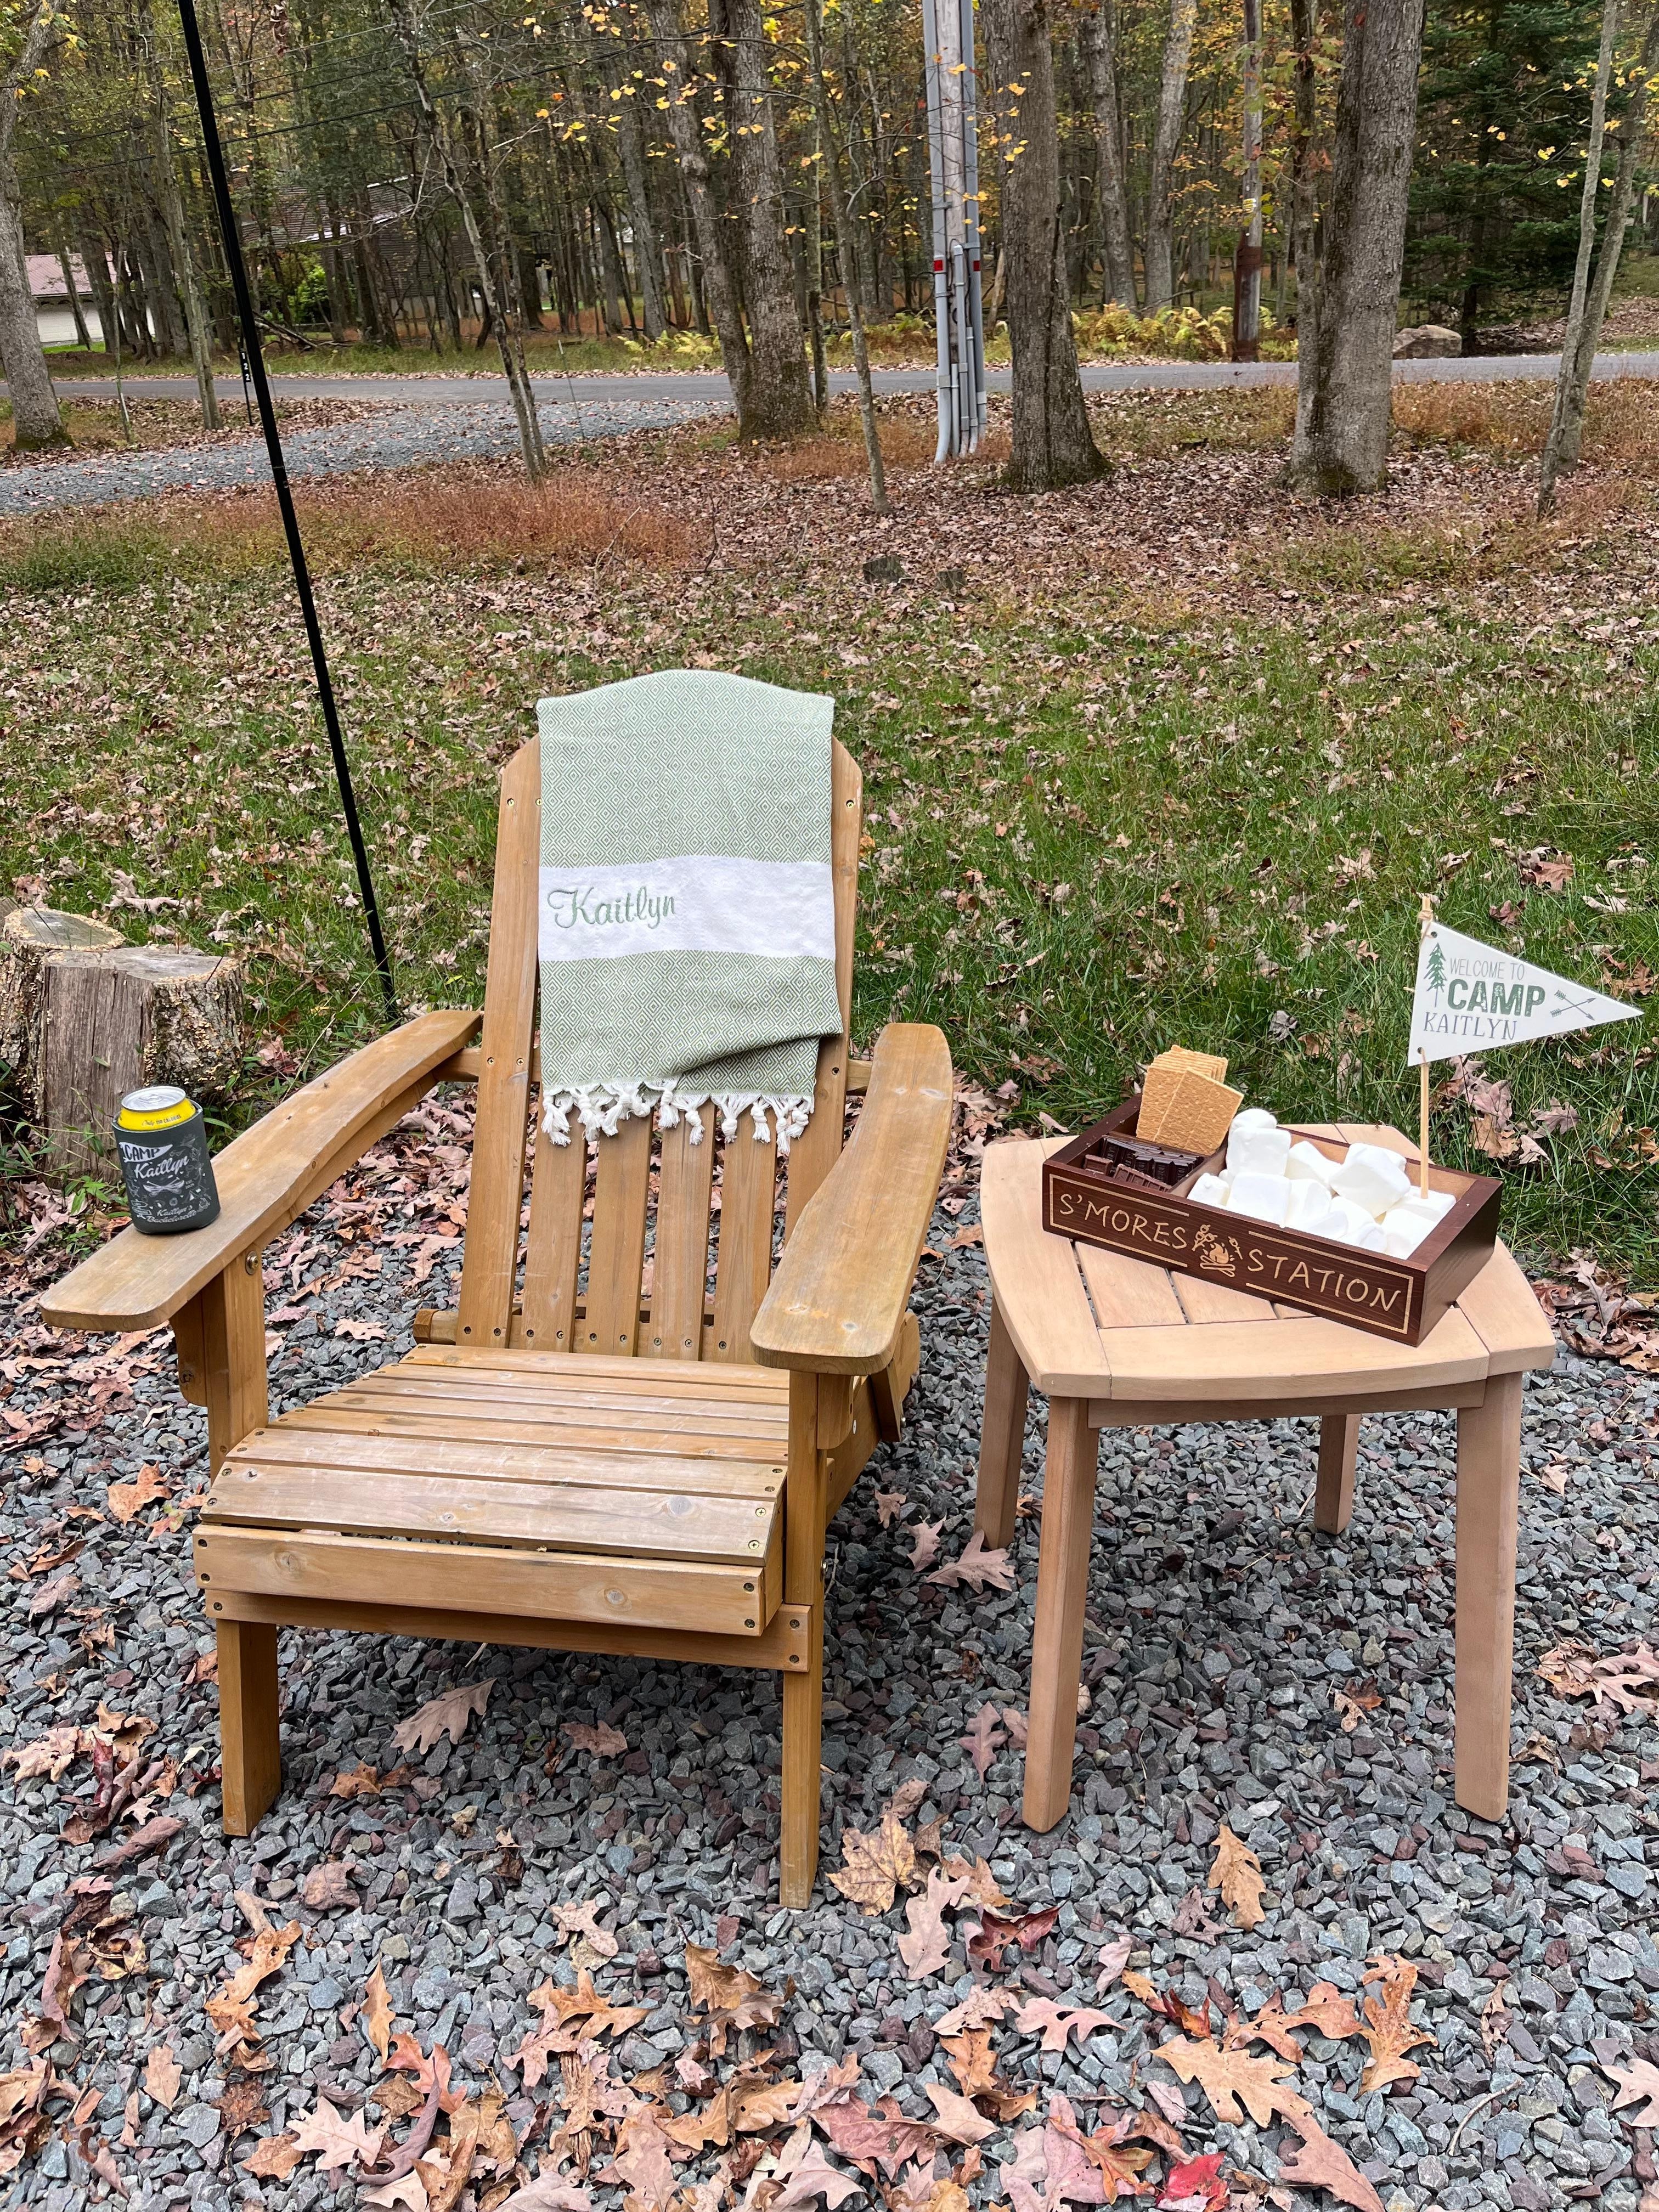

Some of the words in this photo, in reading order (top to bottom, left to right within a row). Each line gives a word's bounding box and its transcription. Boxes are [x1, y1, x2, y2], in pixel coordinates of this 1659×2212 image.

[241, 352, 251, 381] 122
[547, 885, 675, 929] Kaitlyn
[1450, 958, 1505, 979] WELCOME
[1510, 963, 1525, 981] TO
[1447, 978, 1546, 1018] CAMP
[1424, 1012, 1517, 1041] KAITLYN
[125, 1144, 160, 1161] CAMP
[134, 1155, 190, 1179] Kaitlyn
[1059, 1193, 1187, 1250] S'MORES
[1247, 1249, 1402, 1312] STATION
